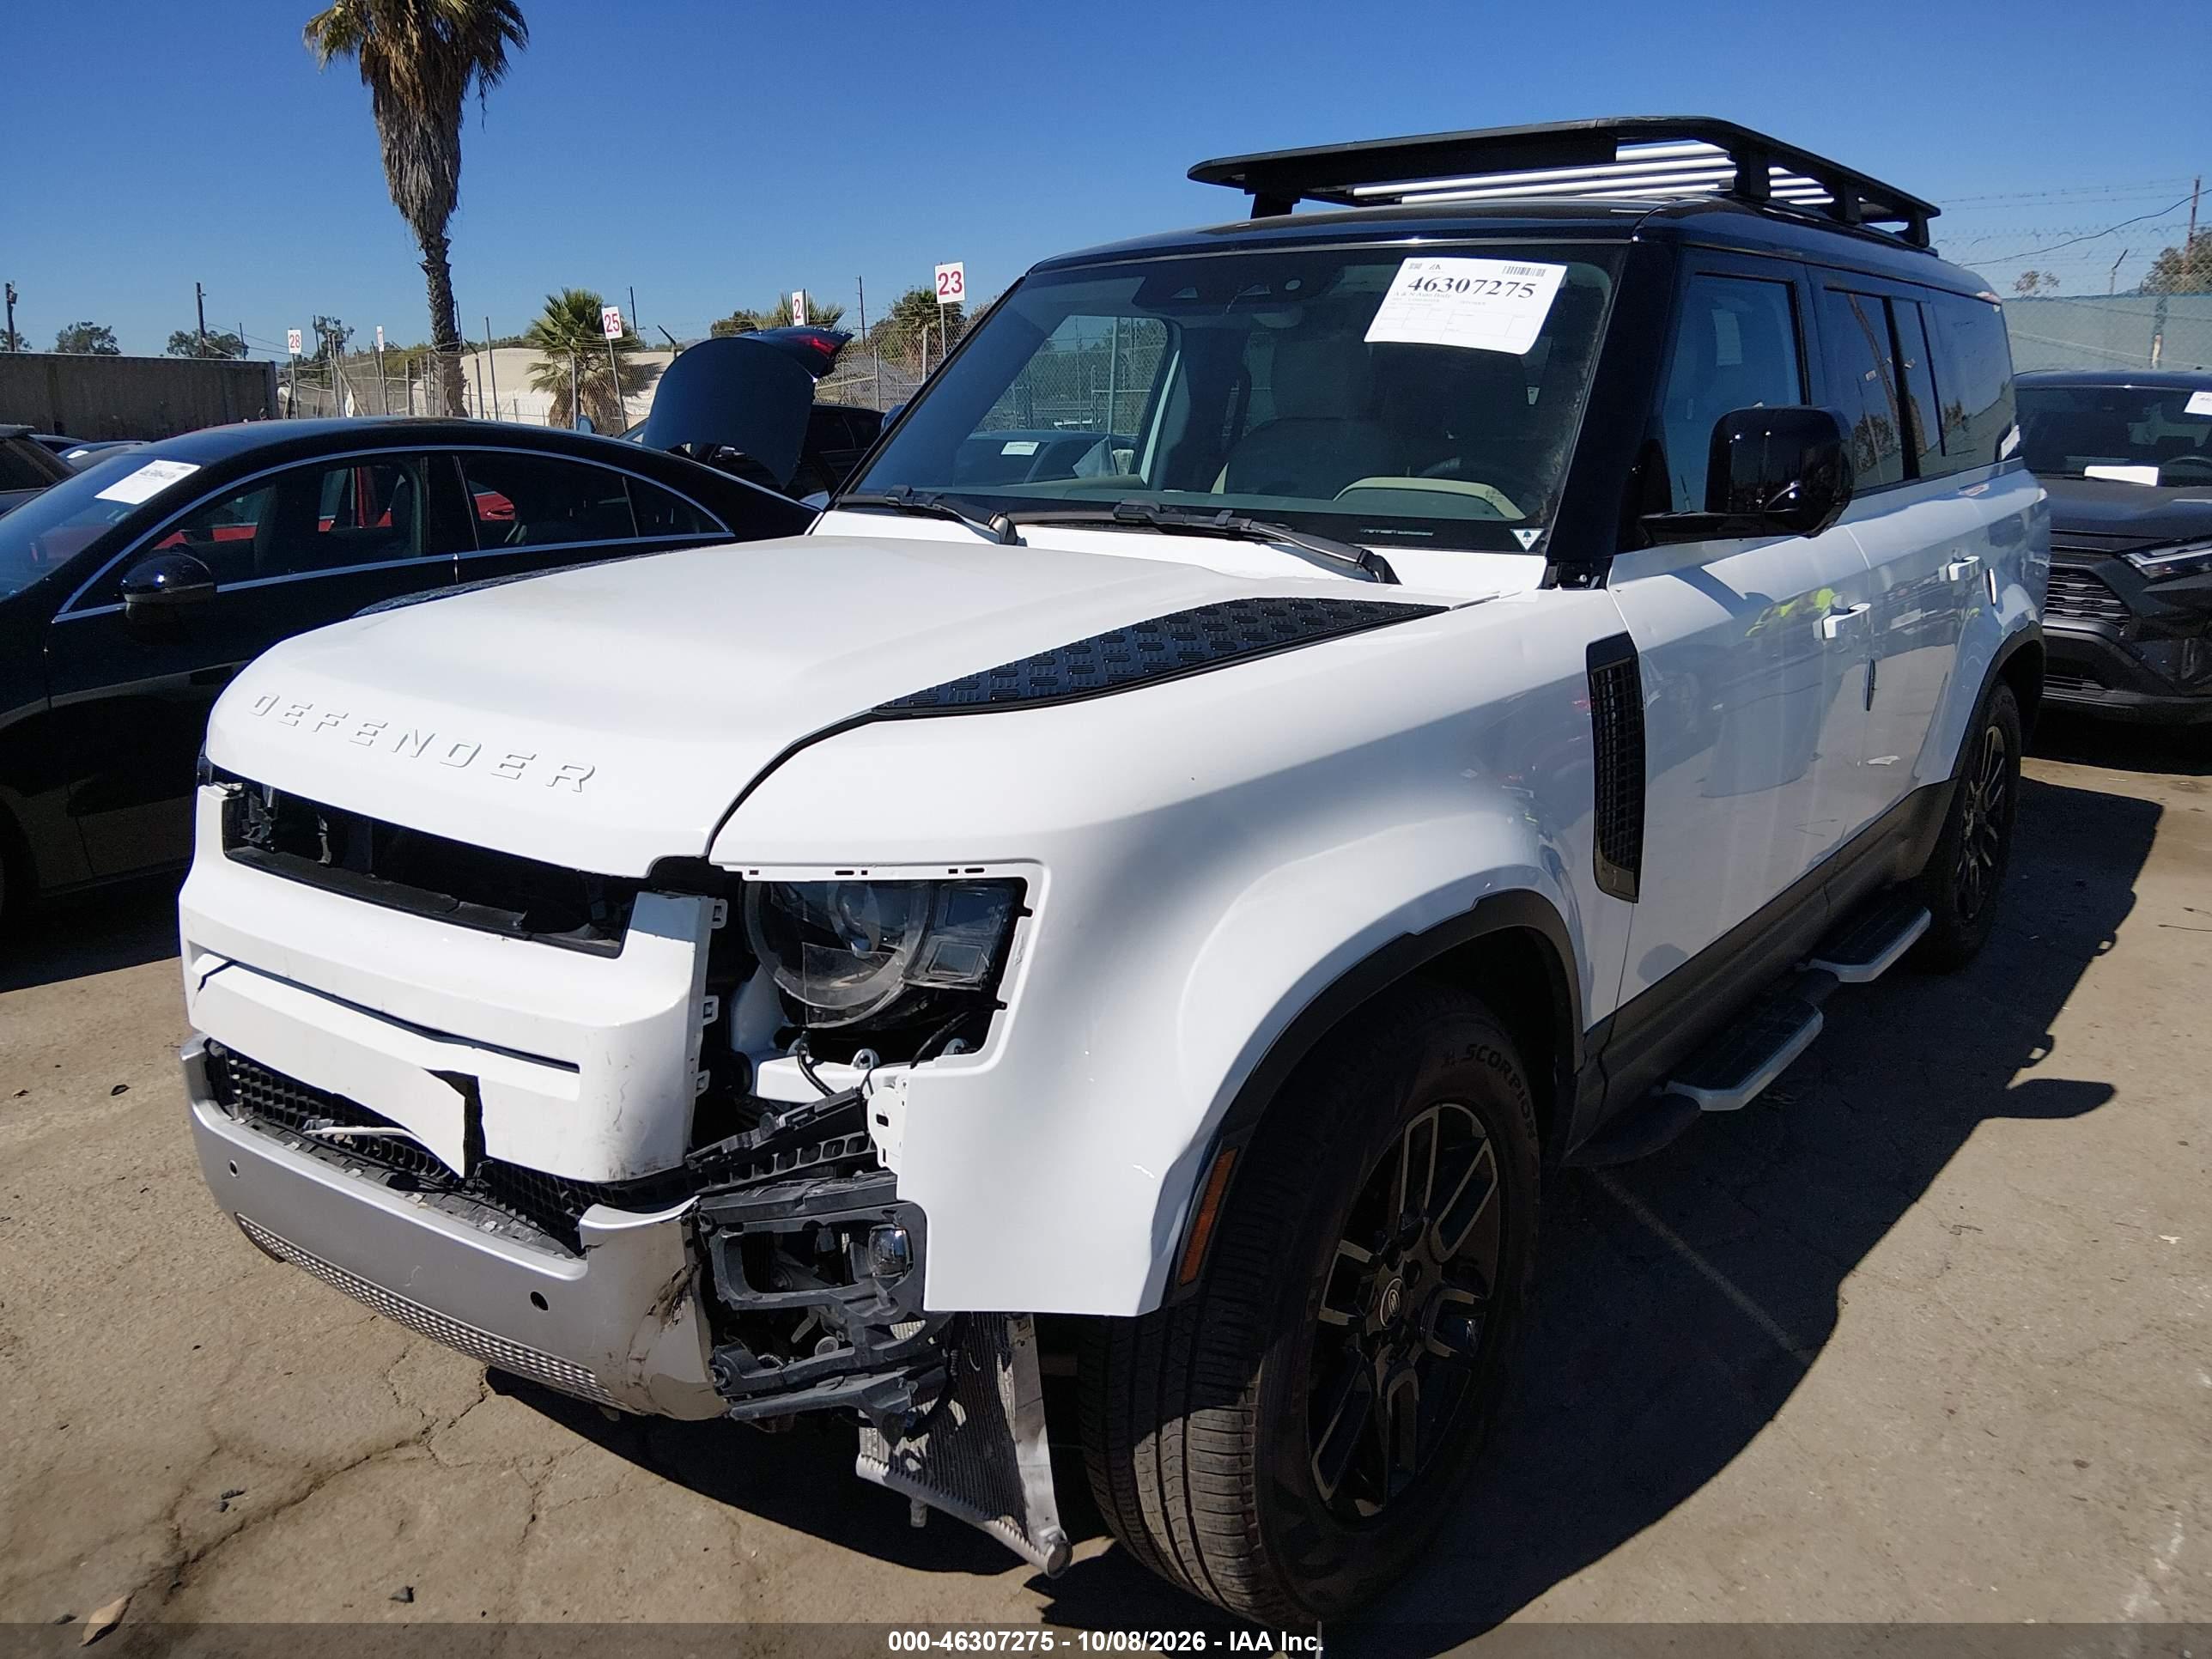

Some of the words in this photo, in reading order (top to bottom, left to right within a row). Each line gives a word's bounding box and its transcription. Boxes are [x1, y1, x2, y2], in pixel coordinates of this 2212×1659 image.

[938, 270, 963, 296] 23
[1407, 276, 1537, 299] 46307275
[793, 298, 804, 319] 2
[604, 313, 620, 332] 25
[289, 334, 301, 349] 28
[248, 693, 596, 793] DEFENDER
